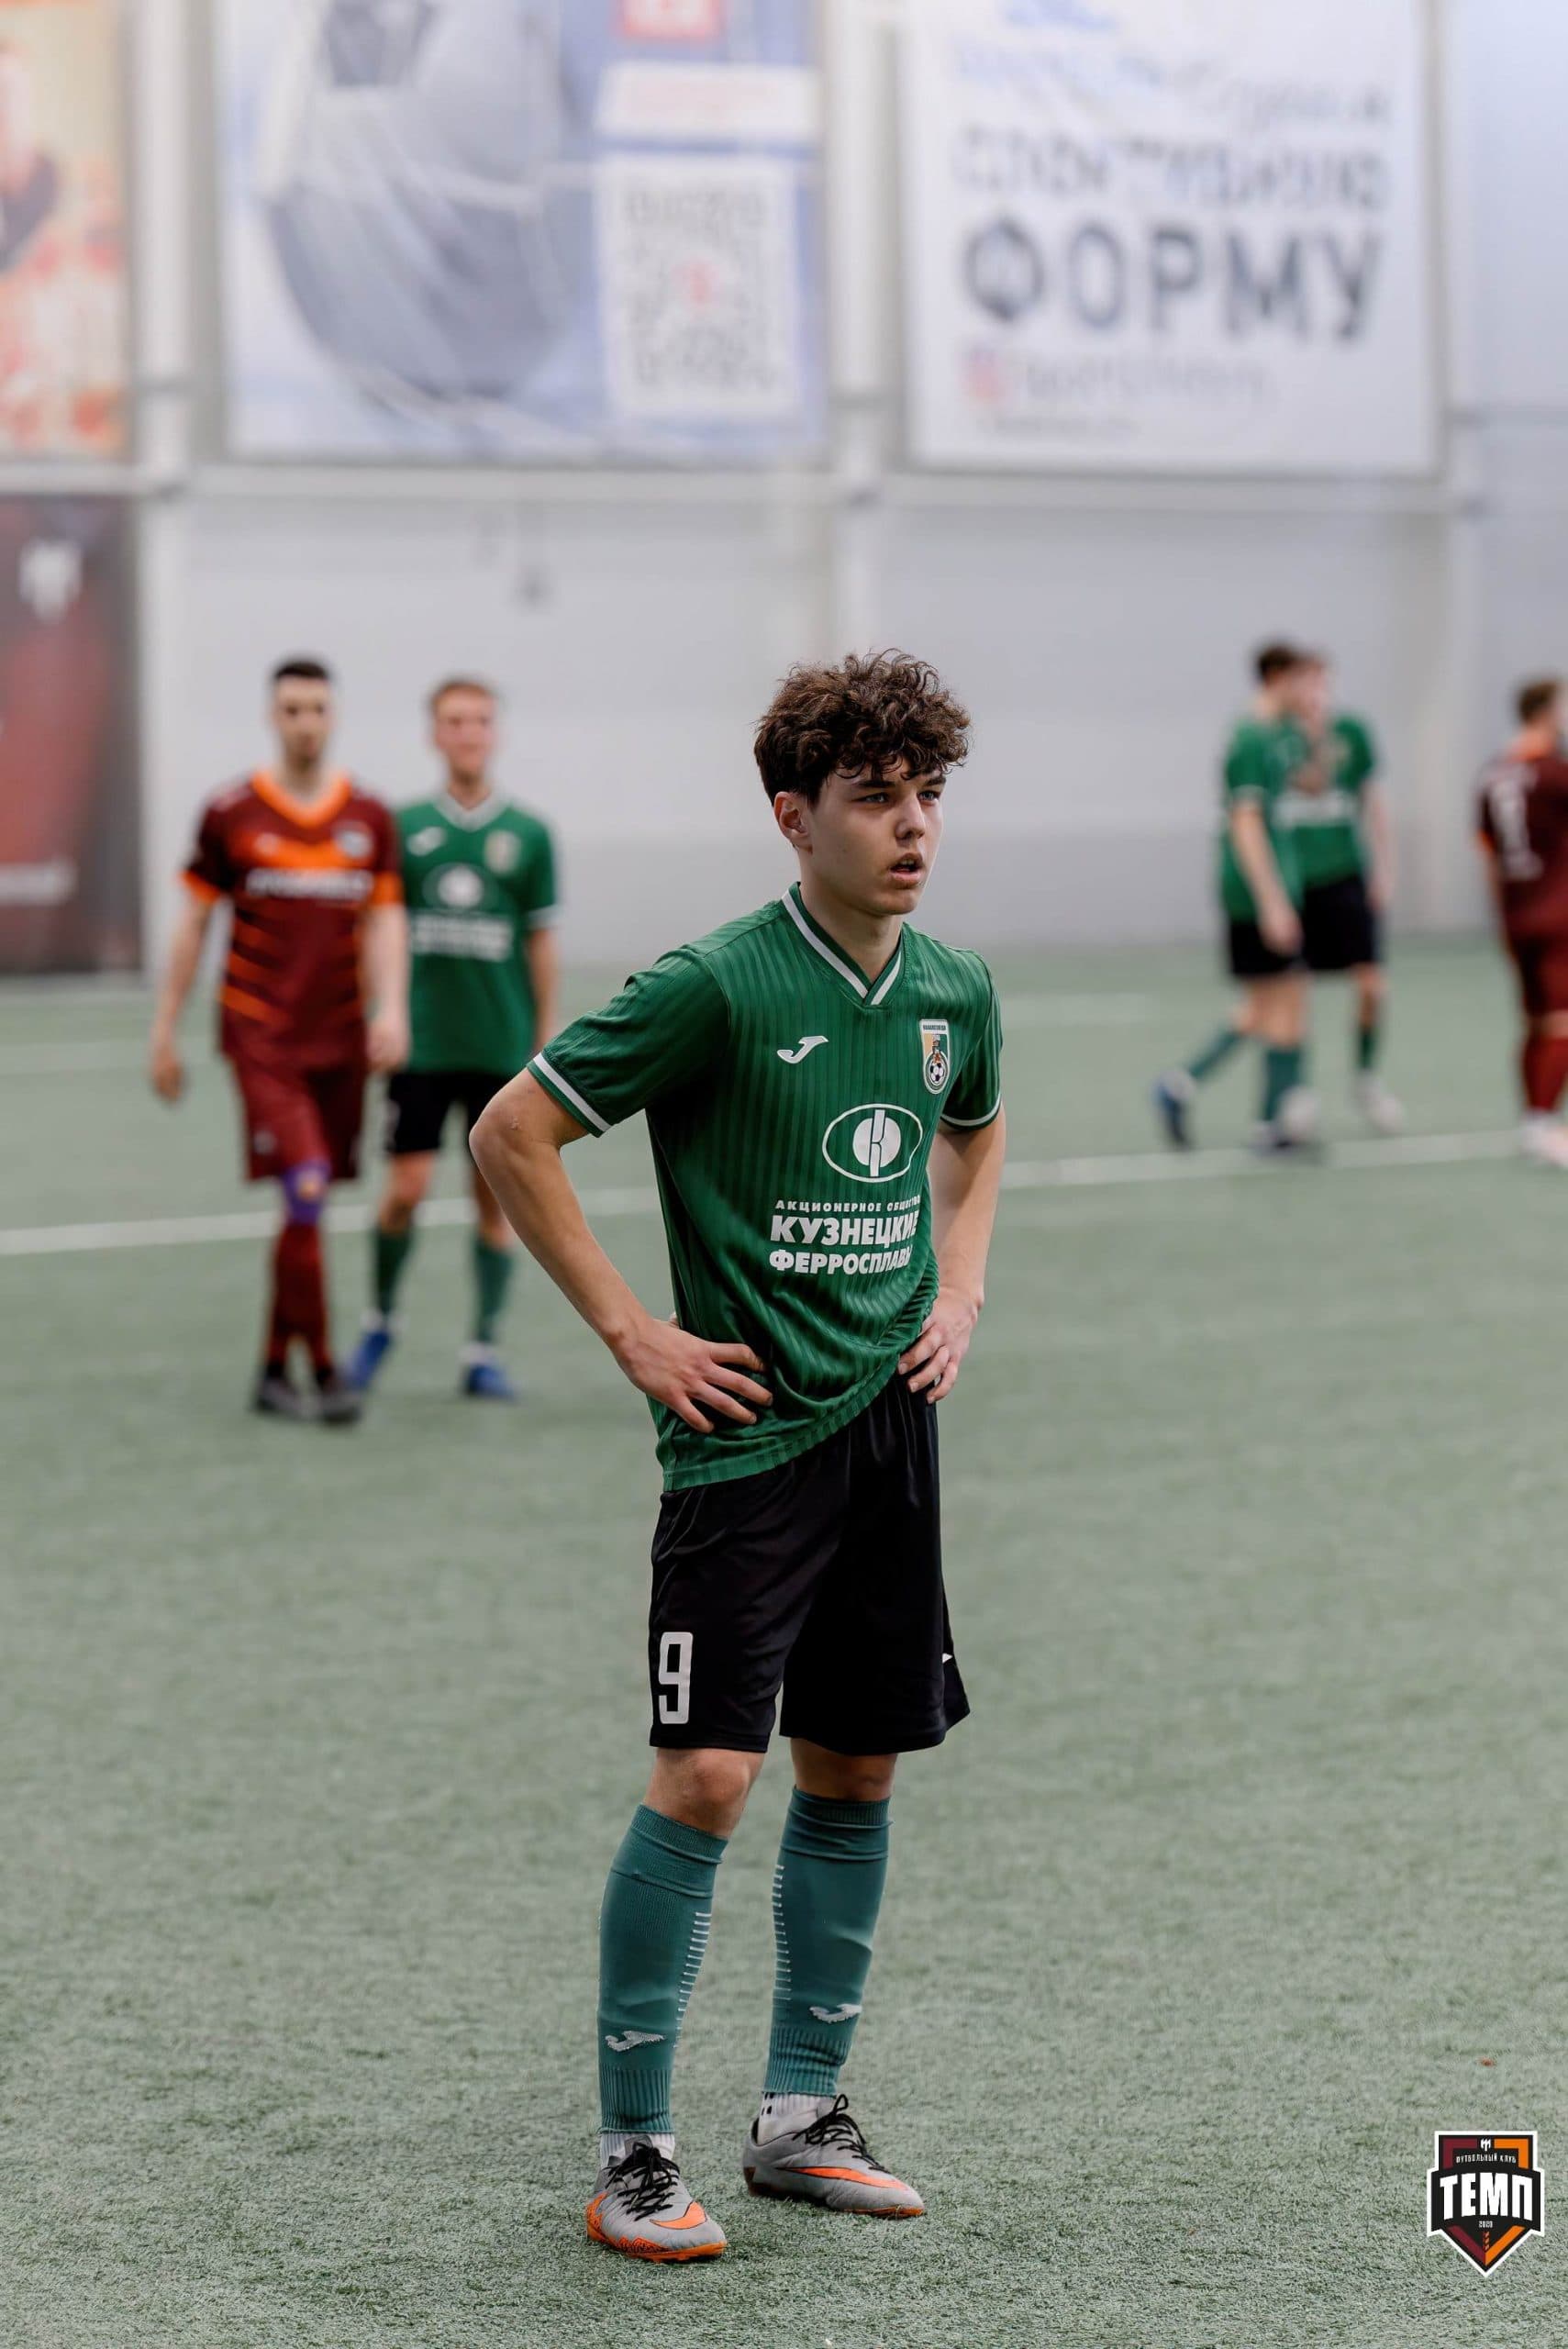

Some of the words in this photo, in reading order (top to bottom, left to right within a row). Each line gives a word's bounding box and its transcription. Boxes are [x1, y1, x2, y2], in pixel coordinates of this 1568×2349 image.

[961, 215, 1383, 346] ФОРМУ
[771, 1209, 920, 1249] КУЗНЕЦКИЕ
[775, 1200, 882, 1213] АКЦИОНЕРНОЕ
[658, 1631, 694, 1724] 9
